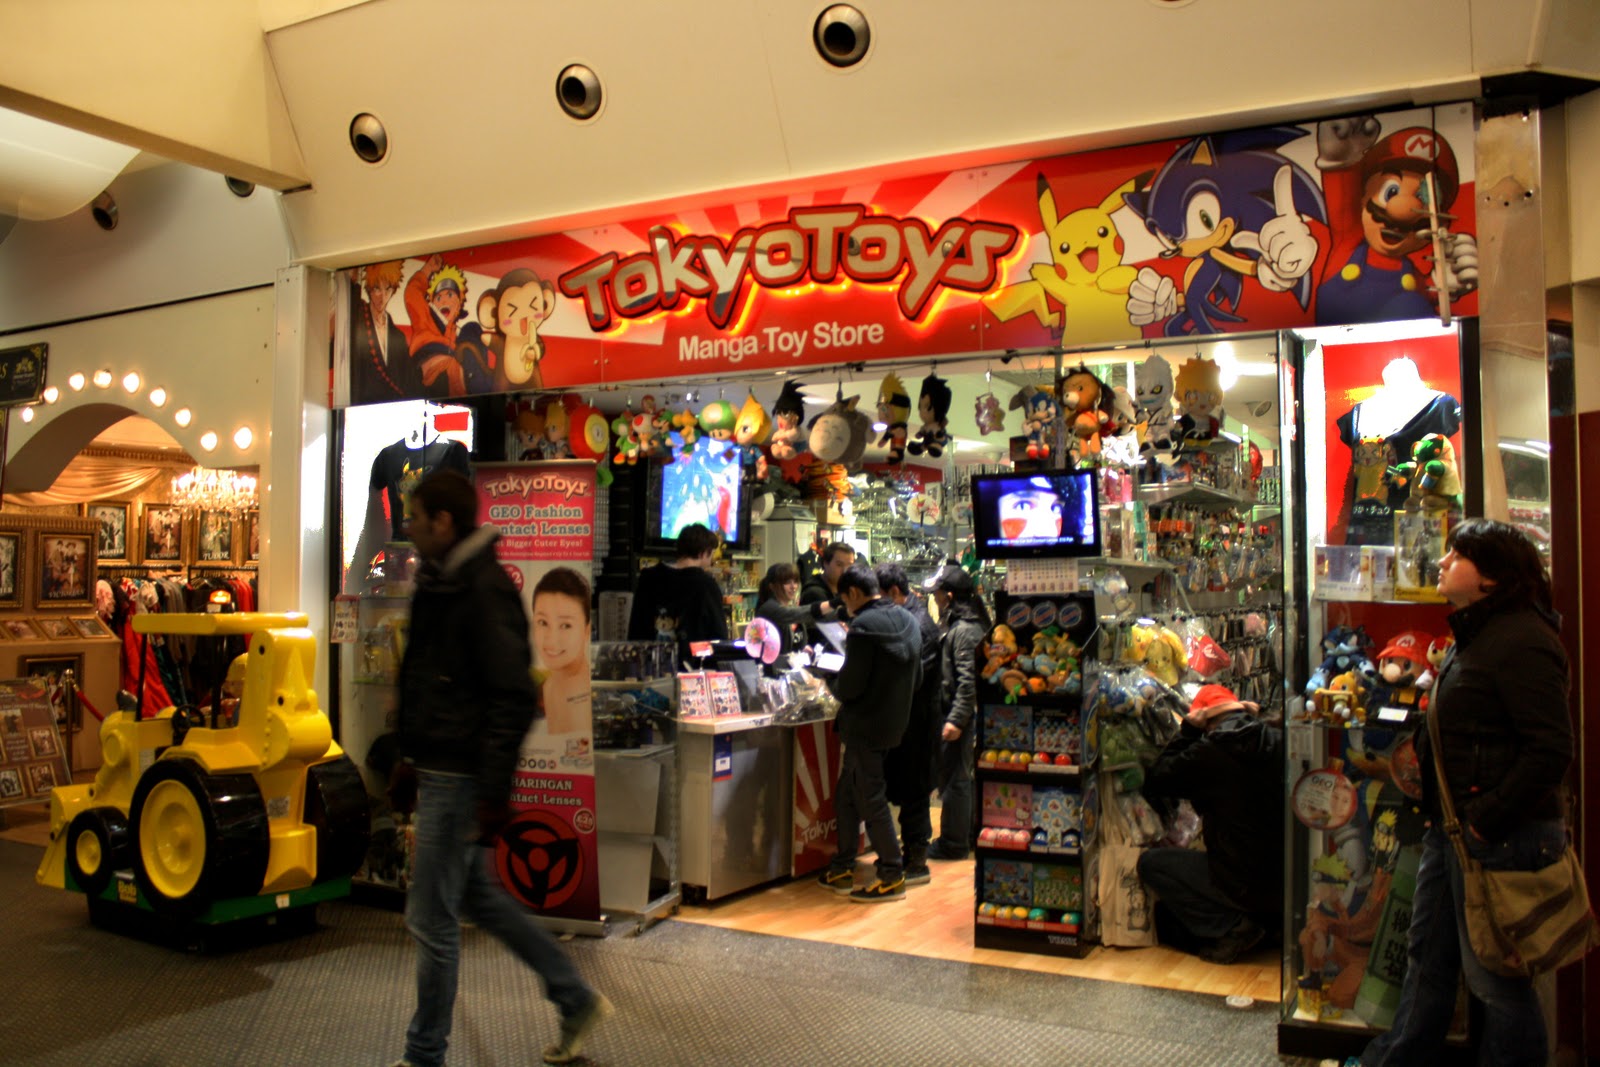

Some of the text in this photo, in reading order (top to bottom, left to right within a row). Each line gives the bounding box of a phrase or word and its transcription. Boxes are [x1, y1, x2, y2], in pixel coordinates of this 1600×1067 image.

[559, 203, 1019, 332] TokyoToys
[679, 322, 884, 363] Manga Toy Store
[486, 474, 589, 500] TokyoToys
[489, 504, 583, 519] GEO Fashion
[540, 522, 590, 535] Lenses
[506, 539, 532, 549] Bigger
[534, 539, 557, 547] Cuter
[559, 539, 583, 549] Eyes!
[202, 551, 230, 560] TUDOR
[511, 776, 573, 791] HARINGAN
[542, 794, 583, 806] Lenses
